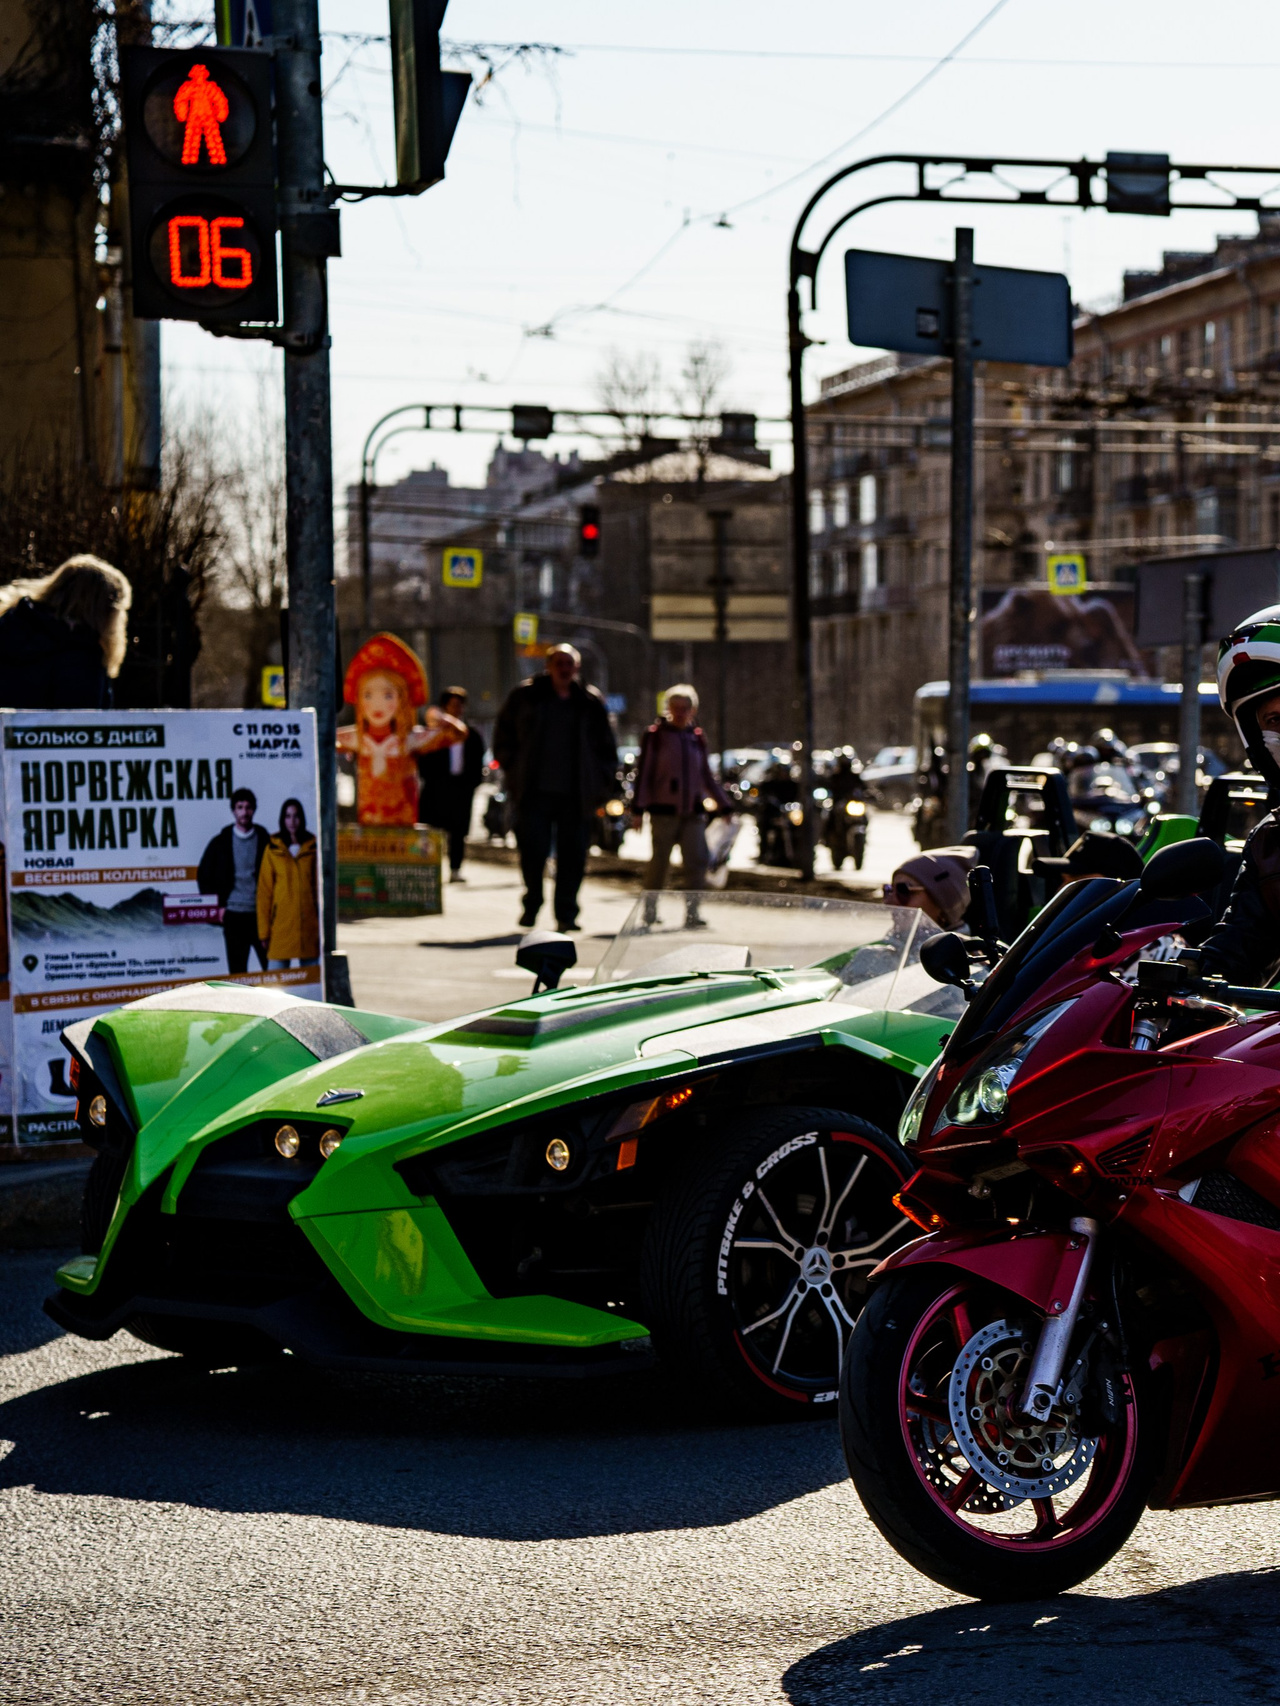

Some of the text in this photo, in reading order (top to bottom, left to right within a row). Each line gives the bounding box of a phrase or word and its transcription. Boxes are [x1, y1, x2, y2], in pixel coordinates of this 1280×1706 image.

[168, 215, 252, 288] 06
[14, 728, 157, 746] ТОЛЬКО 5 ДНЕЙ
[233, 723, 301, 736] С 11 ПО 15
[249, 738, 301, 750] МАРТА
[20, 758, 233, 804] НОРВЕЖСКАЯ
[23, 806, 178, 851] ЯРМАРКА
[24, 857, 74, 868] НОВАЯ
[24, 868, 187, 885] ВЕСЕННЯЯ КОЛЛЕКЦИЯ
[31, 996, 39, 1007] В
[42, 993, 80, 1007] СВЯЗИ
[82, 994, 91, 1003] С
[93, 983, 171, 1001] ОКОНЧАНИЕМ
[717, 1131, 818, 1295] PITBIKE & CROSS
